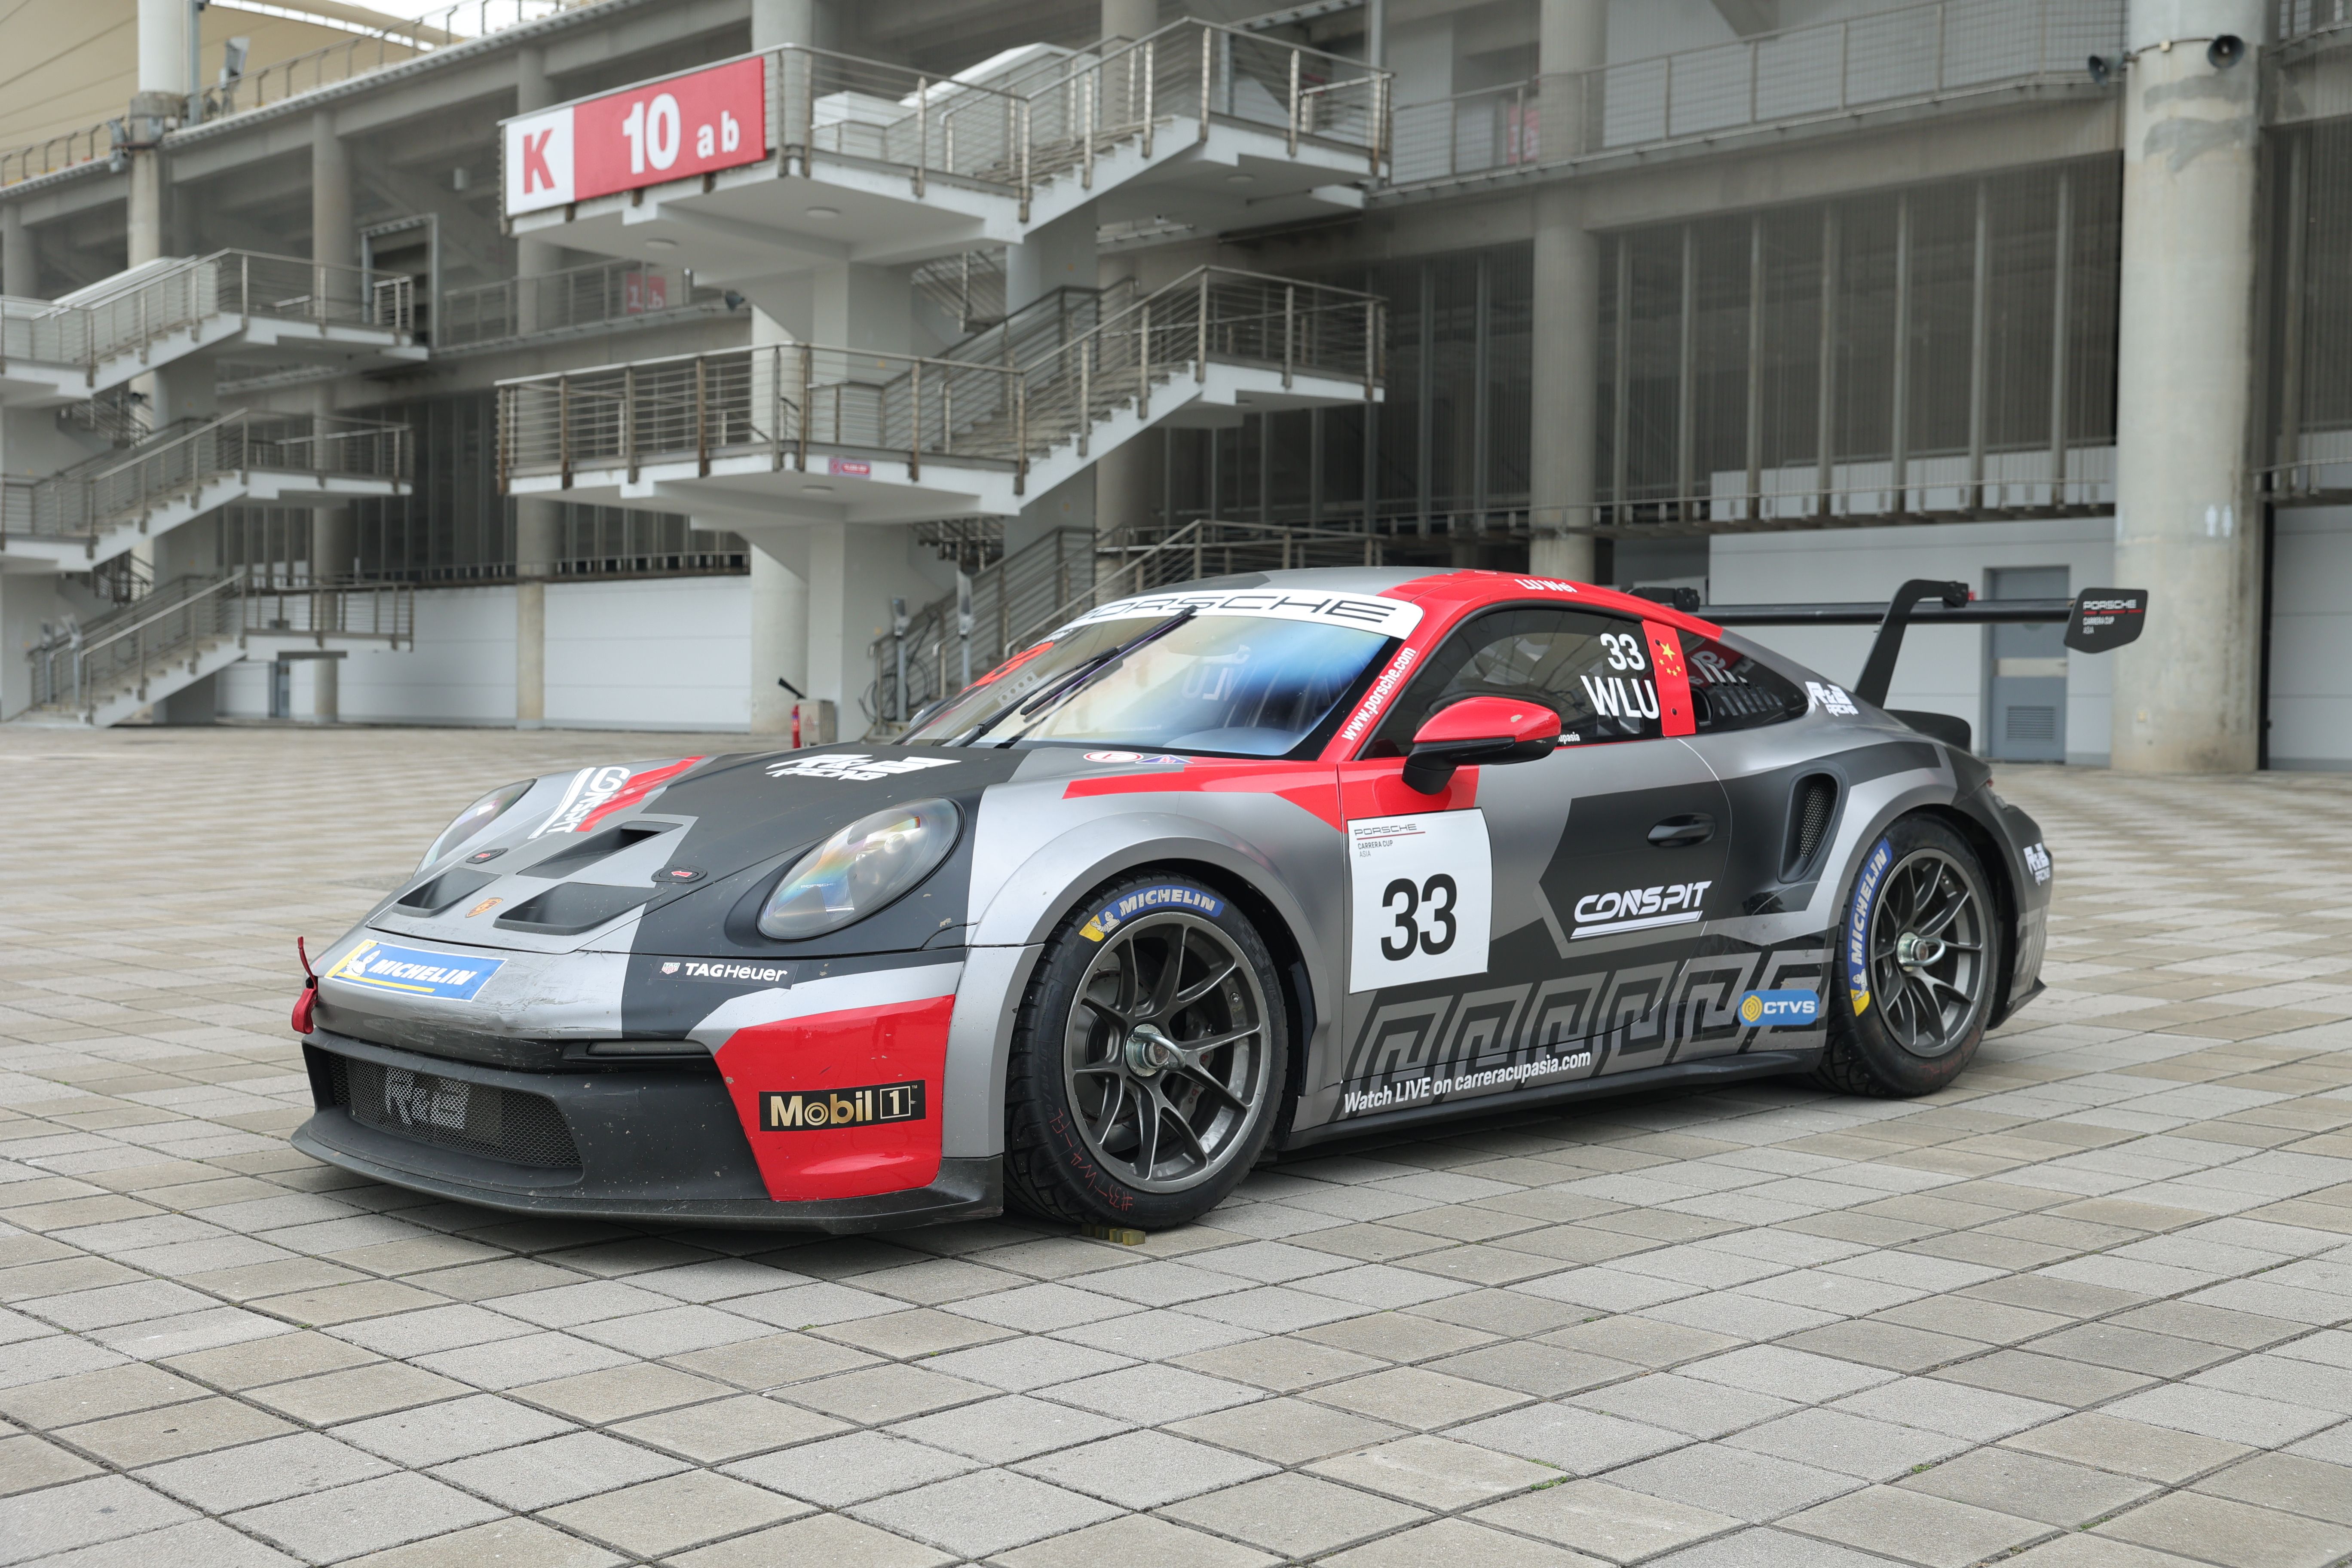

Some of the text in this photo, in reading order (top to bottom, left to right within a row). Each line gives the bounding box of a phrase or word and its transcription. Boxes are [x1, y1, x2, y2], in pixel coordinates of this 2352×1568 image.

[523, 129, 555, 194] K
[622, 93, 681, 175] 10
[1073, 596, 1396, 624] PORSCHE
[2083, 599, 2136, 610] PORSCHE
[1600, 634, 1645, 671] 33
[1341, 647, 1416, 741] www.porsche.com
[1580, 675, 1660, 719] WLU
[1354, 824, 1417, 836] PORSCHE
[1119, 889, 1216, 917] MICHELIN
[1381, 873, 1457, 961] 33
[1574, 881, 1712, 923] CONSPIT
[1851, 848, 1887, 965] MICHELIN
[368, 959, 477, 986] MICHELIN
[1764, 1001, 1815, 1014] CTVS
[1344, 1051, 1591, 1113] Watch LIVE on carreracupasia.com
[771, 1090, 872, 1126] Mobil
